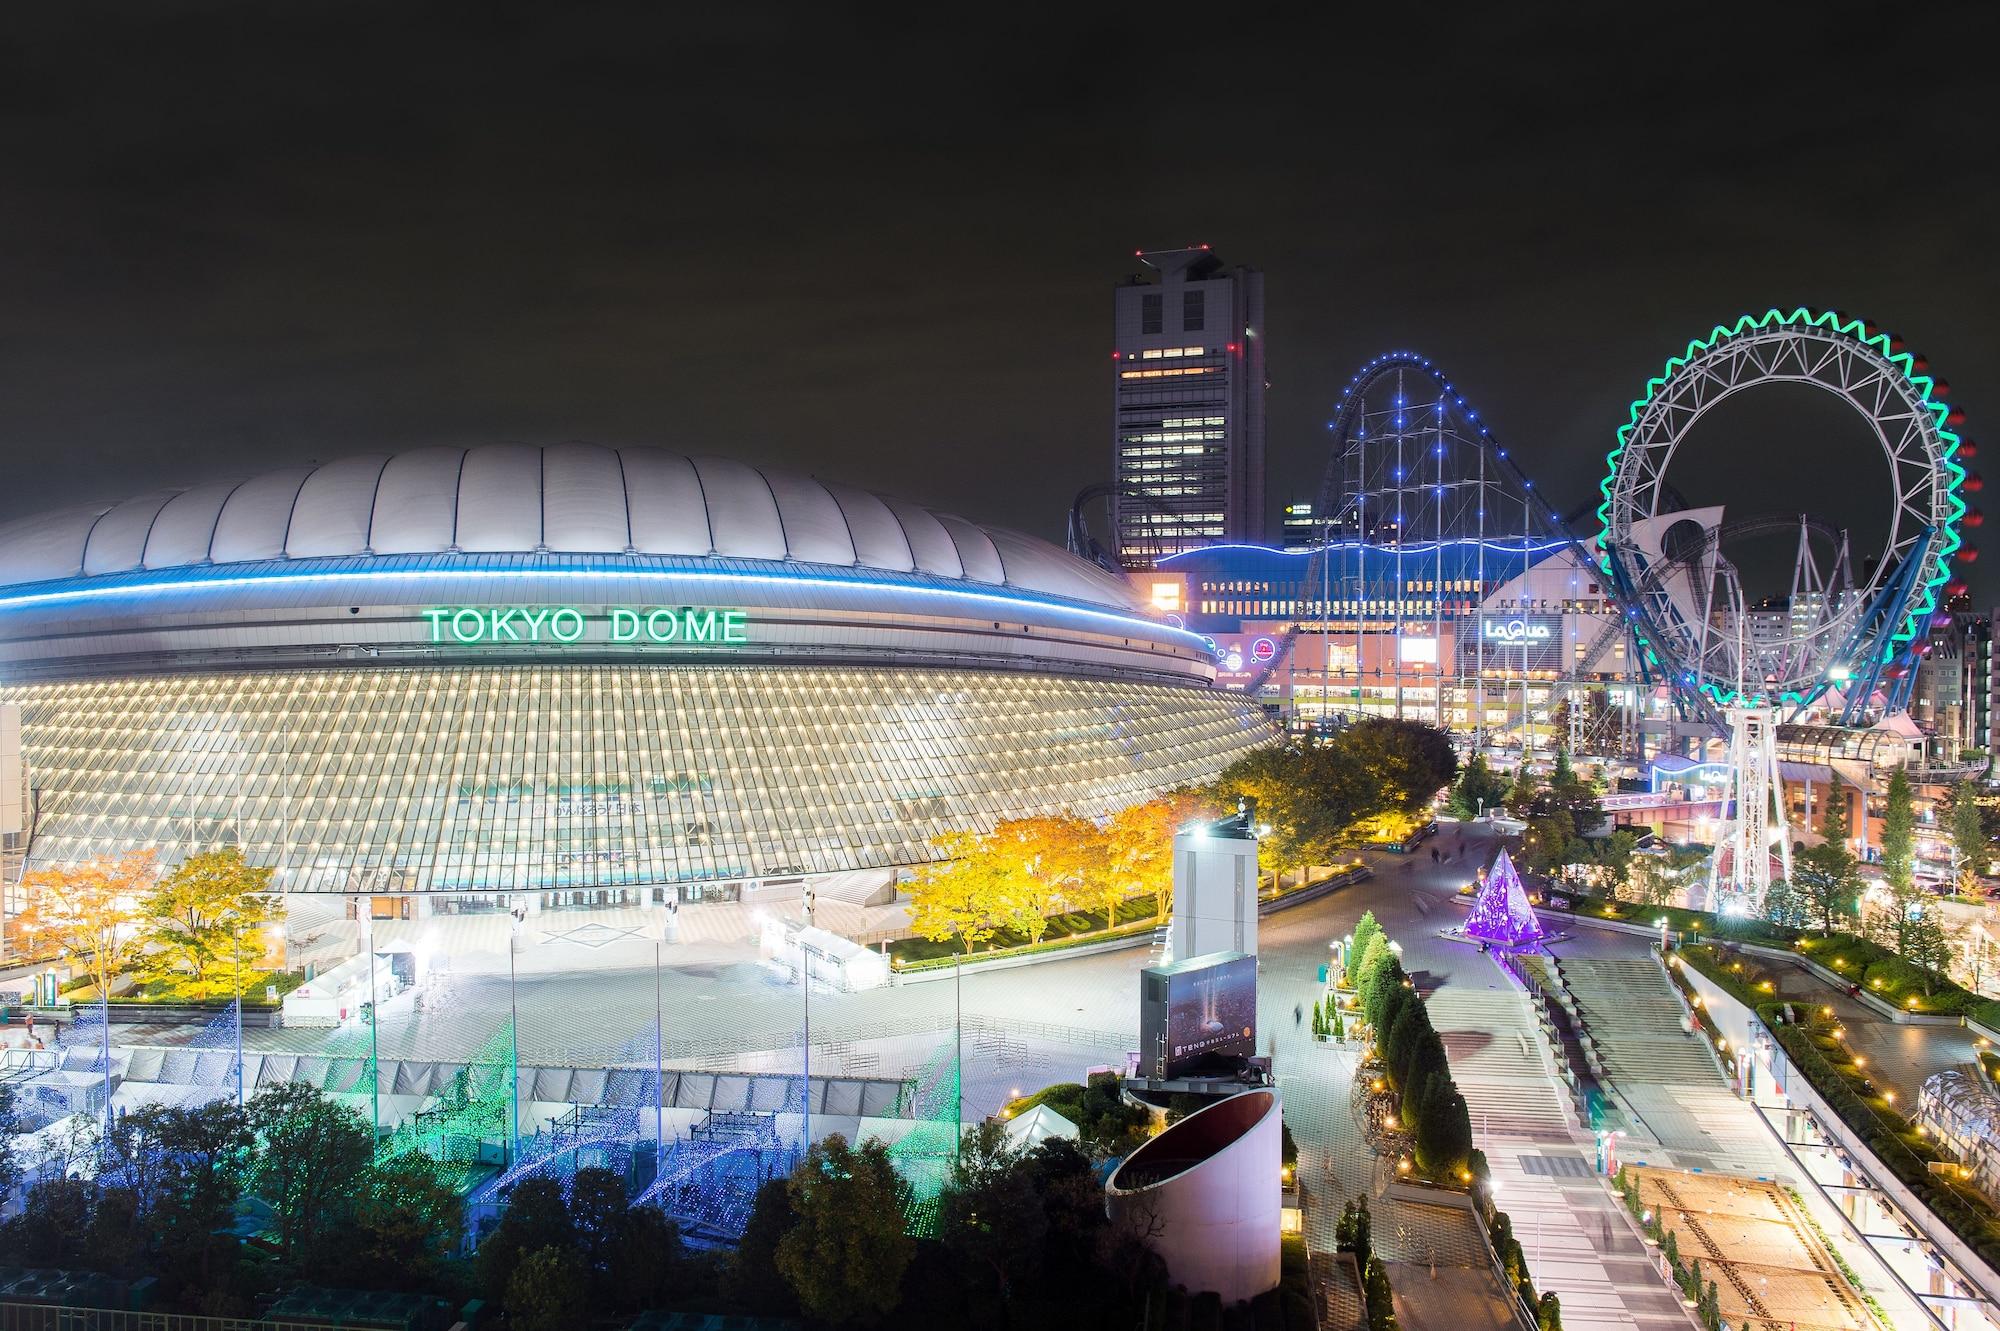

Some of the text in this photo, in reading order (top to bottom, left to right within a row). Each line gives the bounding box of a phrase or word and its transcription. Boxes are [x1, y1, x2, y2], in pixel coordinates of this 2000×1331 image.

[422, 608, 748, 643] TOKYO DOME
[1485, 620, 1550, 641] LaQua
